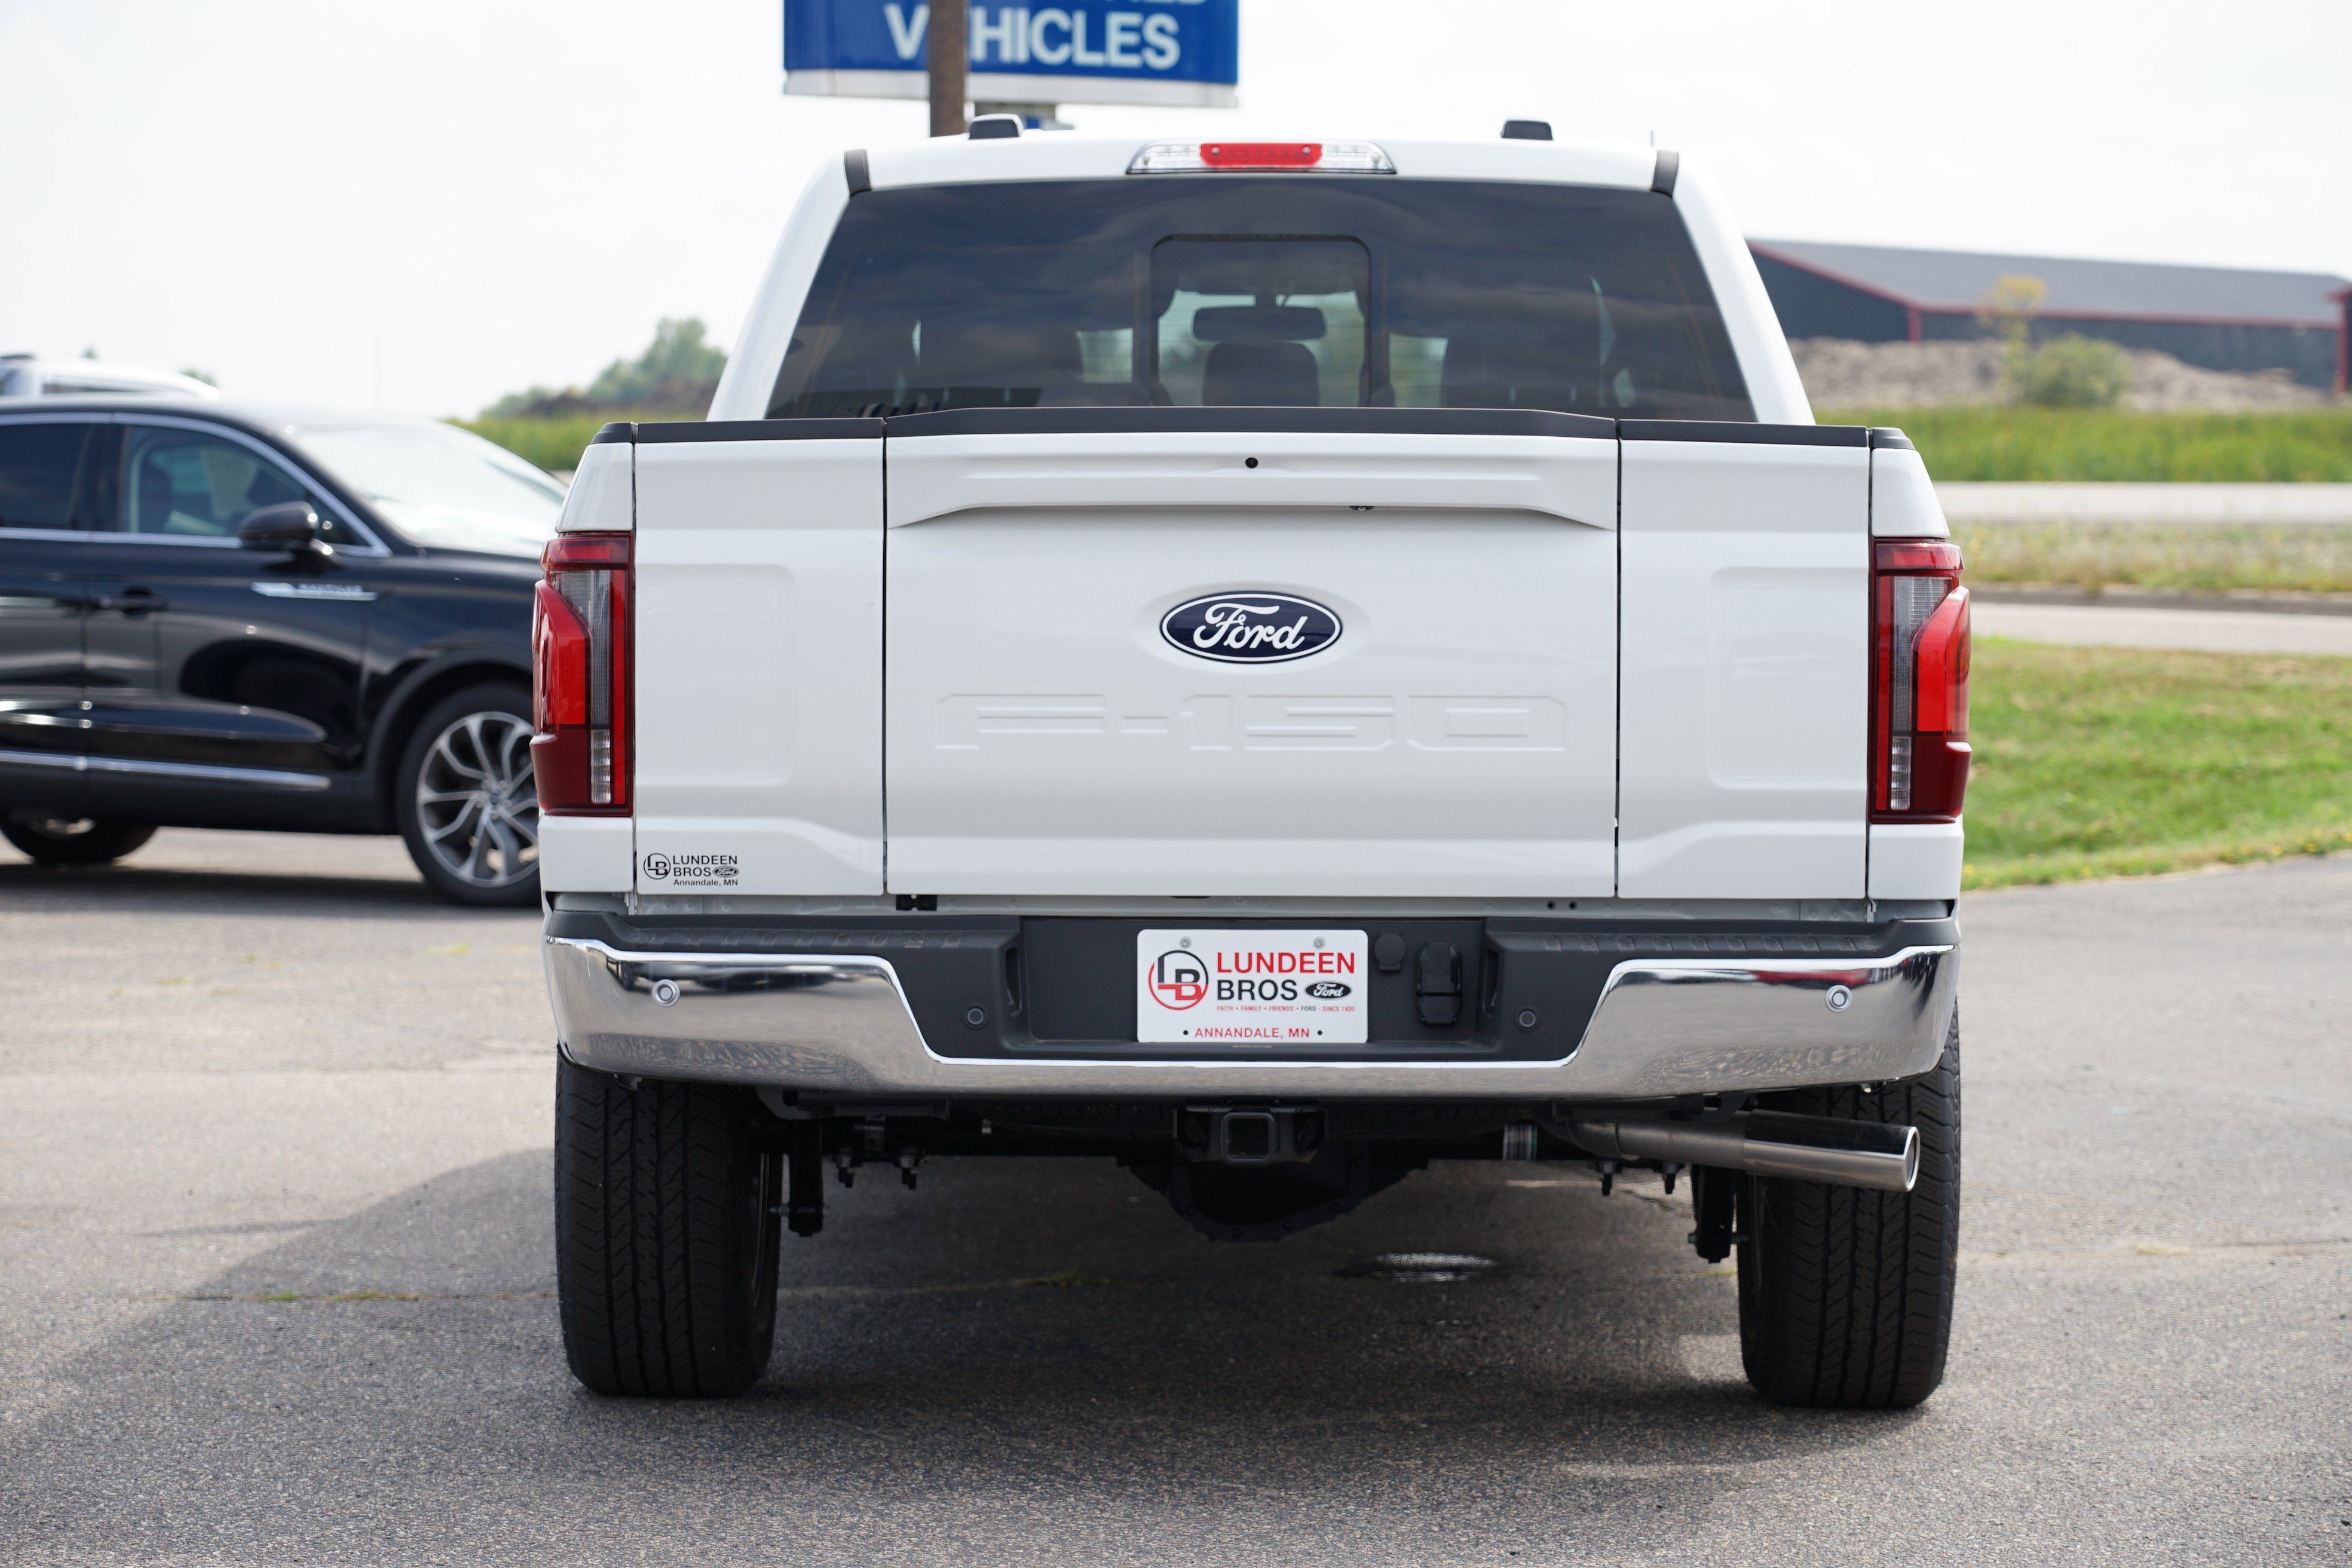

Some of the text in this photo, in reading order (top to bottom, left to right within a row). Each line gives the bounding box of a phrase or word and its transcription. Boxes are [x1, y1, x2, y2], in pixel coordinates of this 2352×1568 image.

[884, 3, 1181, 69] VHICLES
[1193, 602, 1309, 651] Ford
[935, 693, 1567, 751] F-150
[672, 855, 738, 865] LUNDEEN
[673, 867, 712, 877] BROS
[1217, 952, 1355, 973] LUNDEEN
[1217, 979, 1345, 1001] BROS Ford
[1195, 1027, 1309, 1039] ANNANDALE, MN
